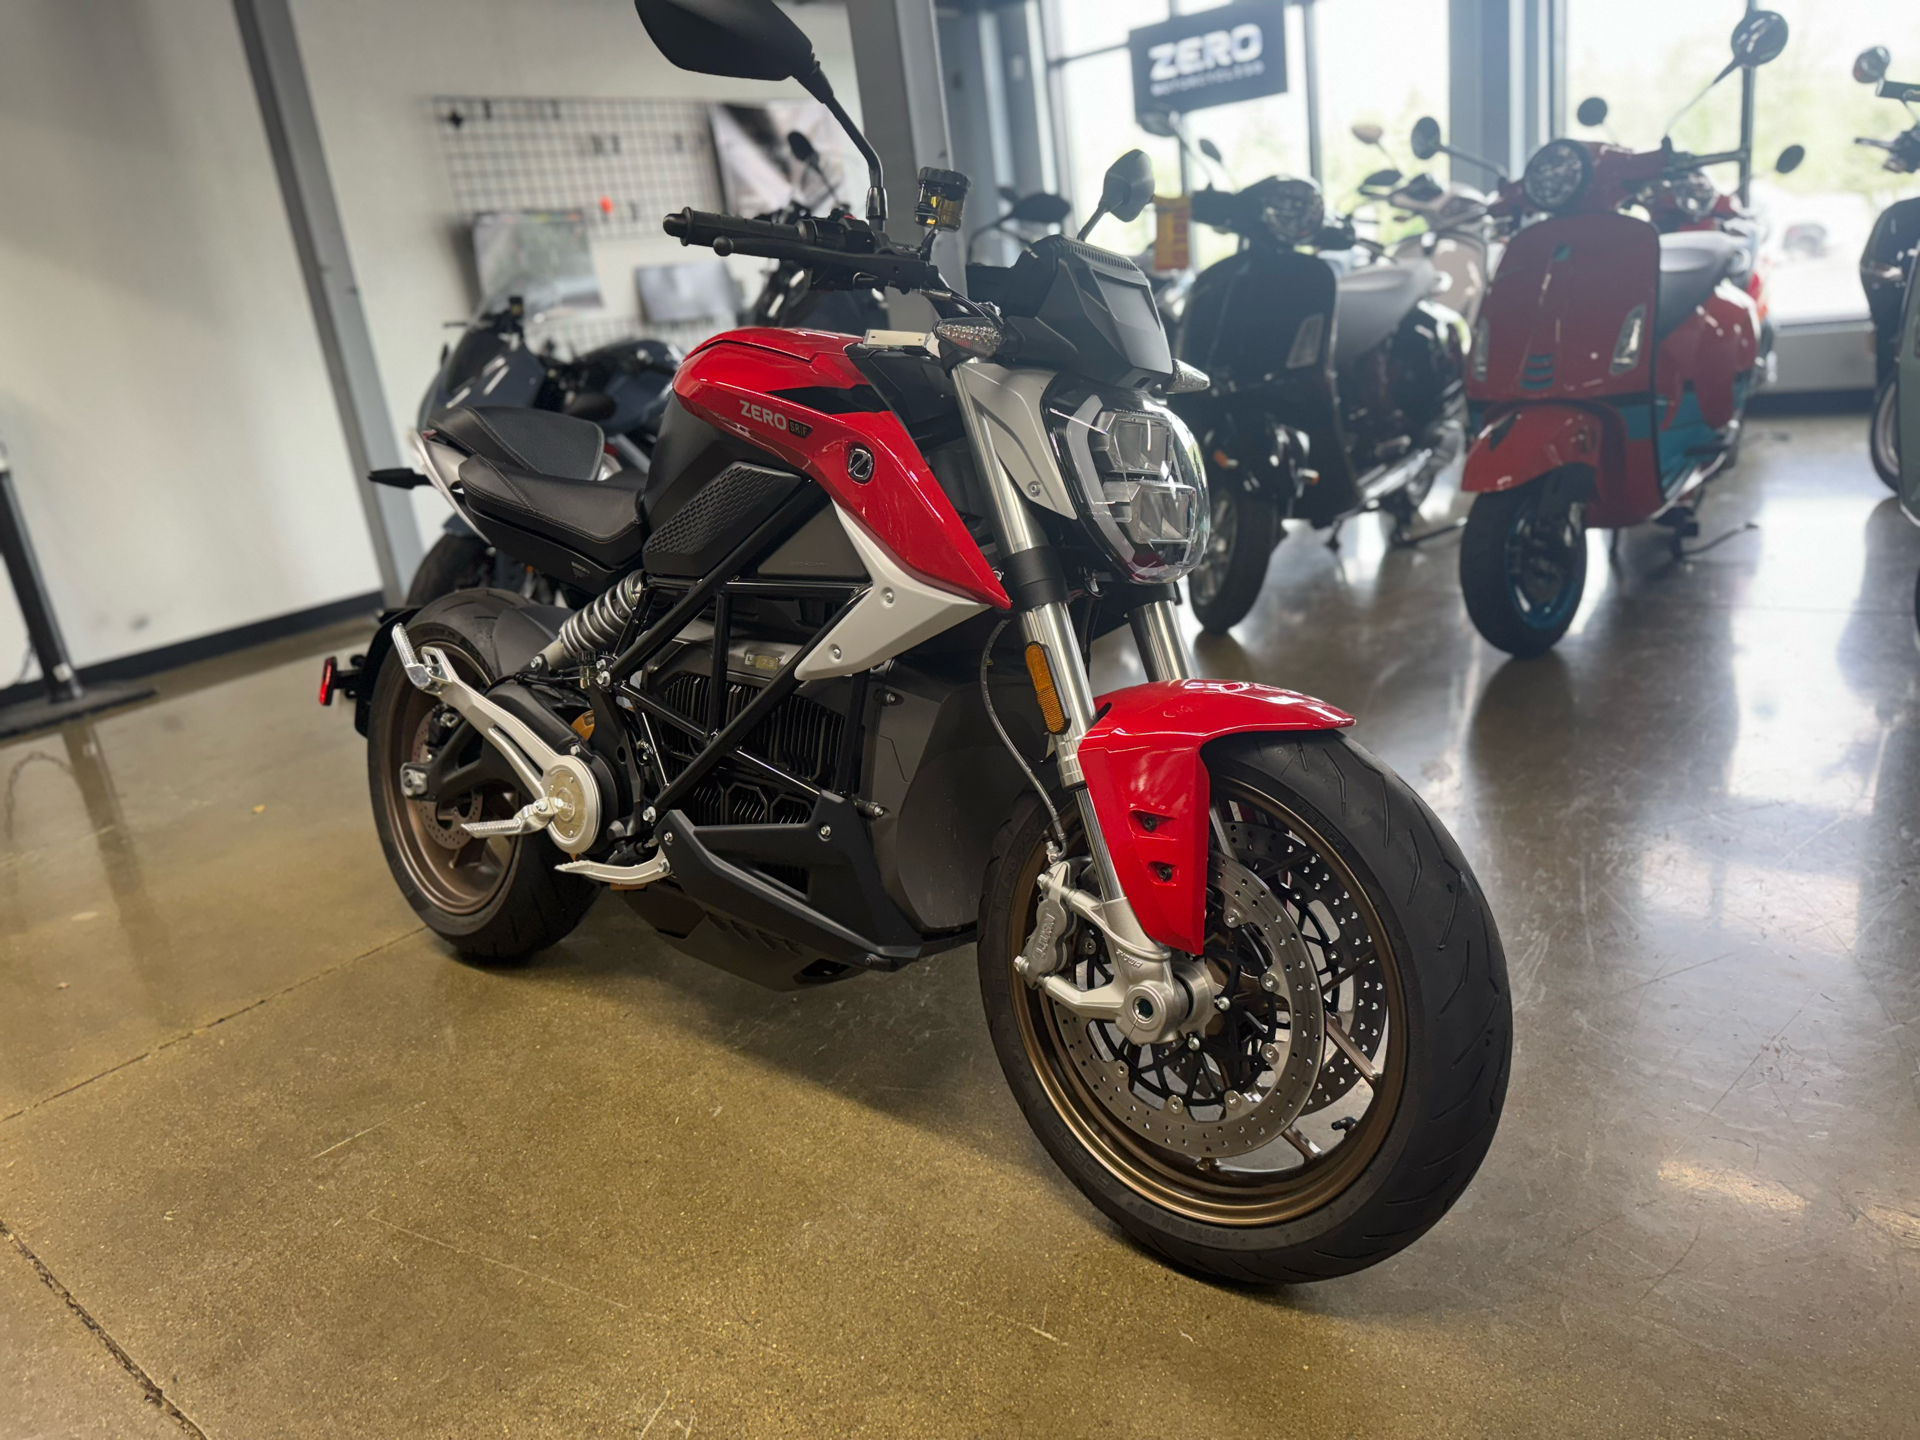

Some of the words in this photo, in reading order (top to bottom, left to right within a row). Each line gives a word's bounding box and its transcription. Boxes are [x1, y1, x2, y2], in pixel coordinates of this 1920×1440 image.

[1148, 23, 1263, 81] ZERO
[740, 400, 787, 430] ZERO
[1051, 1121, 1111, 1189] ROSSO
